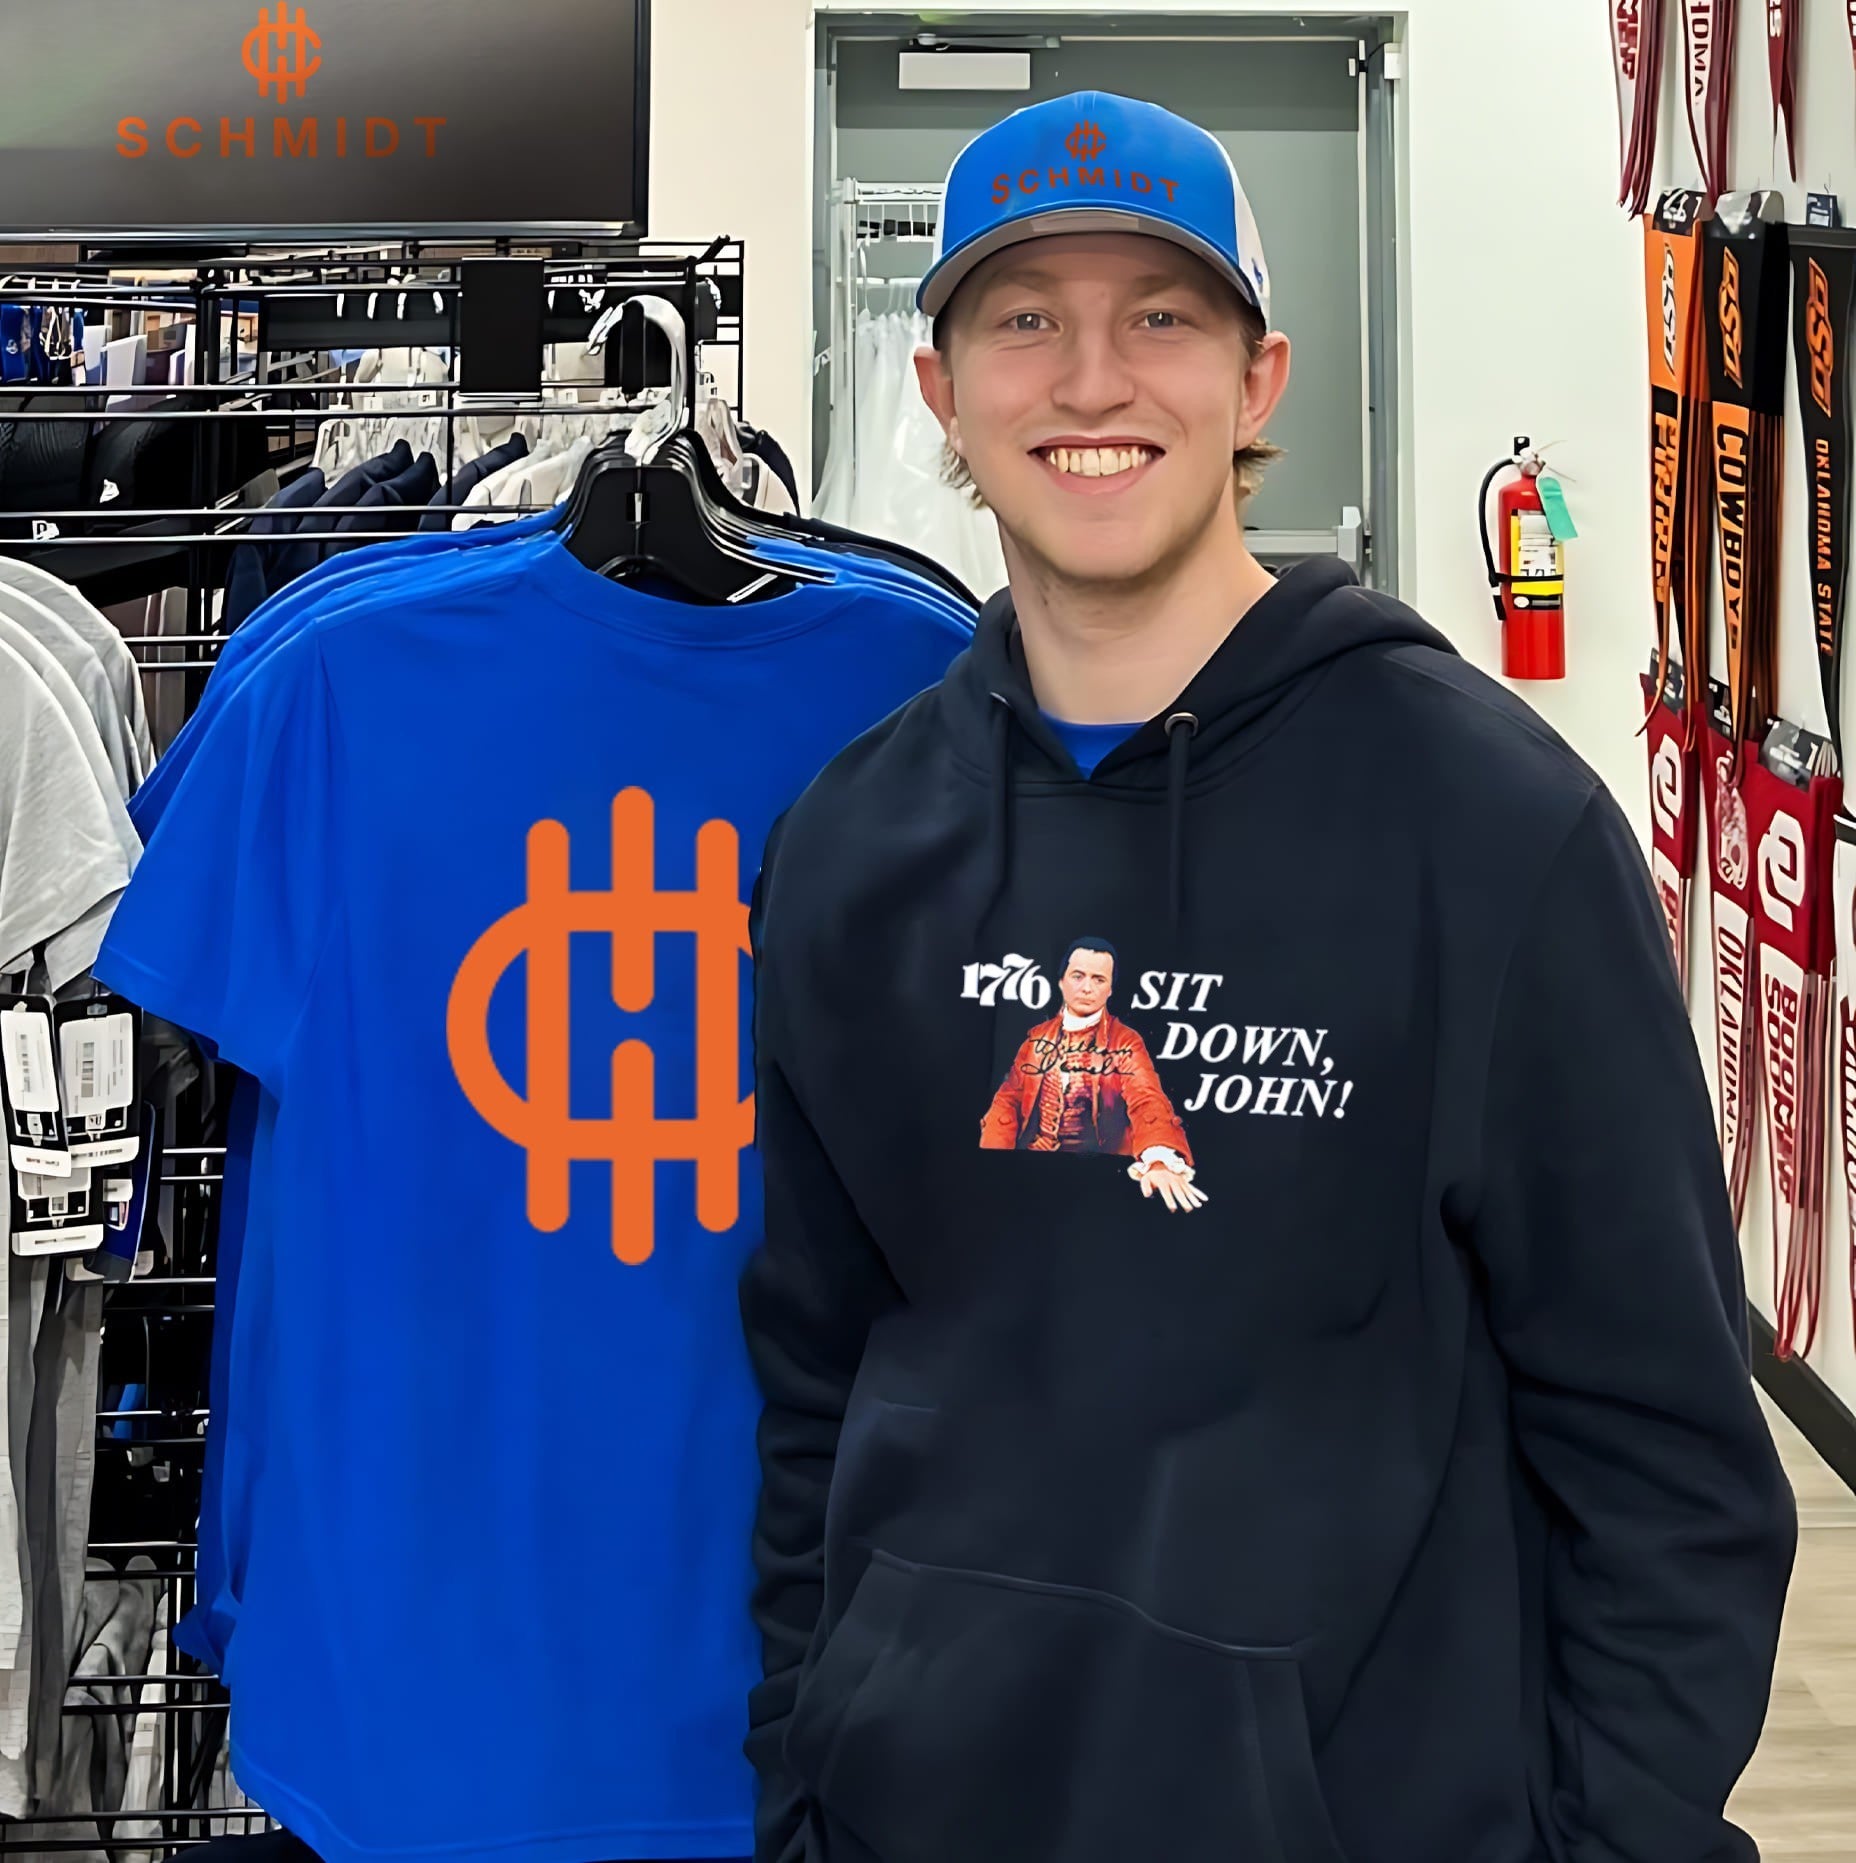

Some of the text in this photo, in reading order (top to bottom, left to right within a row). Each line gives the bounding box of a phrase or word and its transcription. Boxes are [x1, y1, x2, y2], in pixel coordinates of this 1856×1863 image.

[115, 117, 448, 158] SCHMIDT
[991, 167, 1179, 204] SCHMIDT
[1815, 438, 1833, 571] OKLAHOMA
[960, 953, 1052, 1010] 1776
[1131, 970, 1223, 1012] SIT
[1156, 1021, 1335, 1076] DOWN,
[1718, 925, 1746, 1144] OKLAHOMA
[1184, 1073, 1354, 1119] JOHN!
